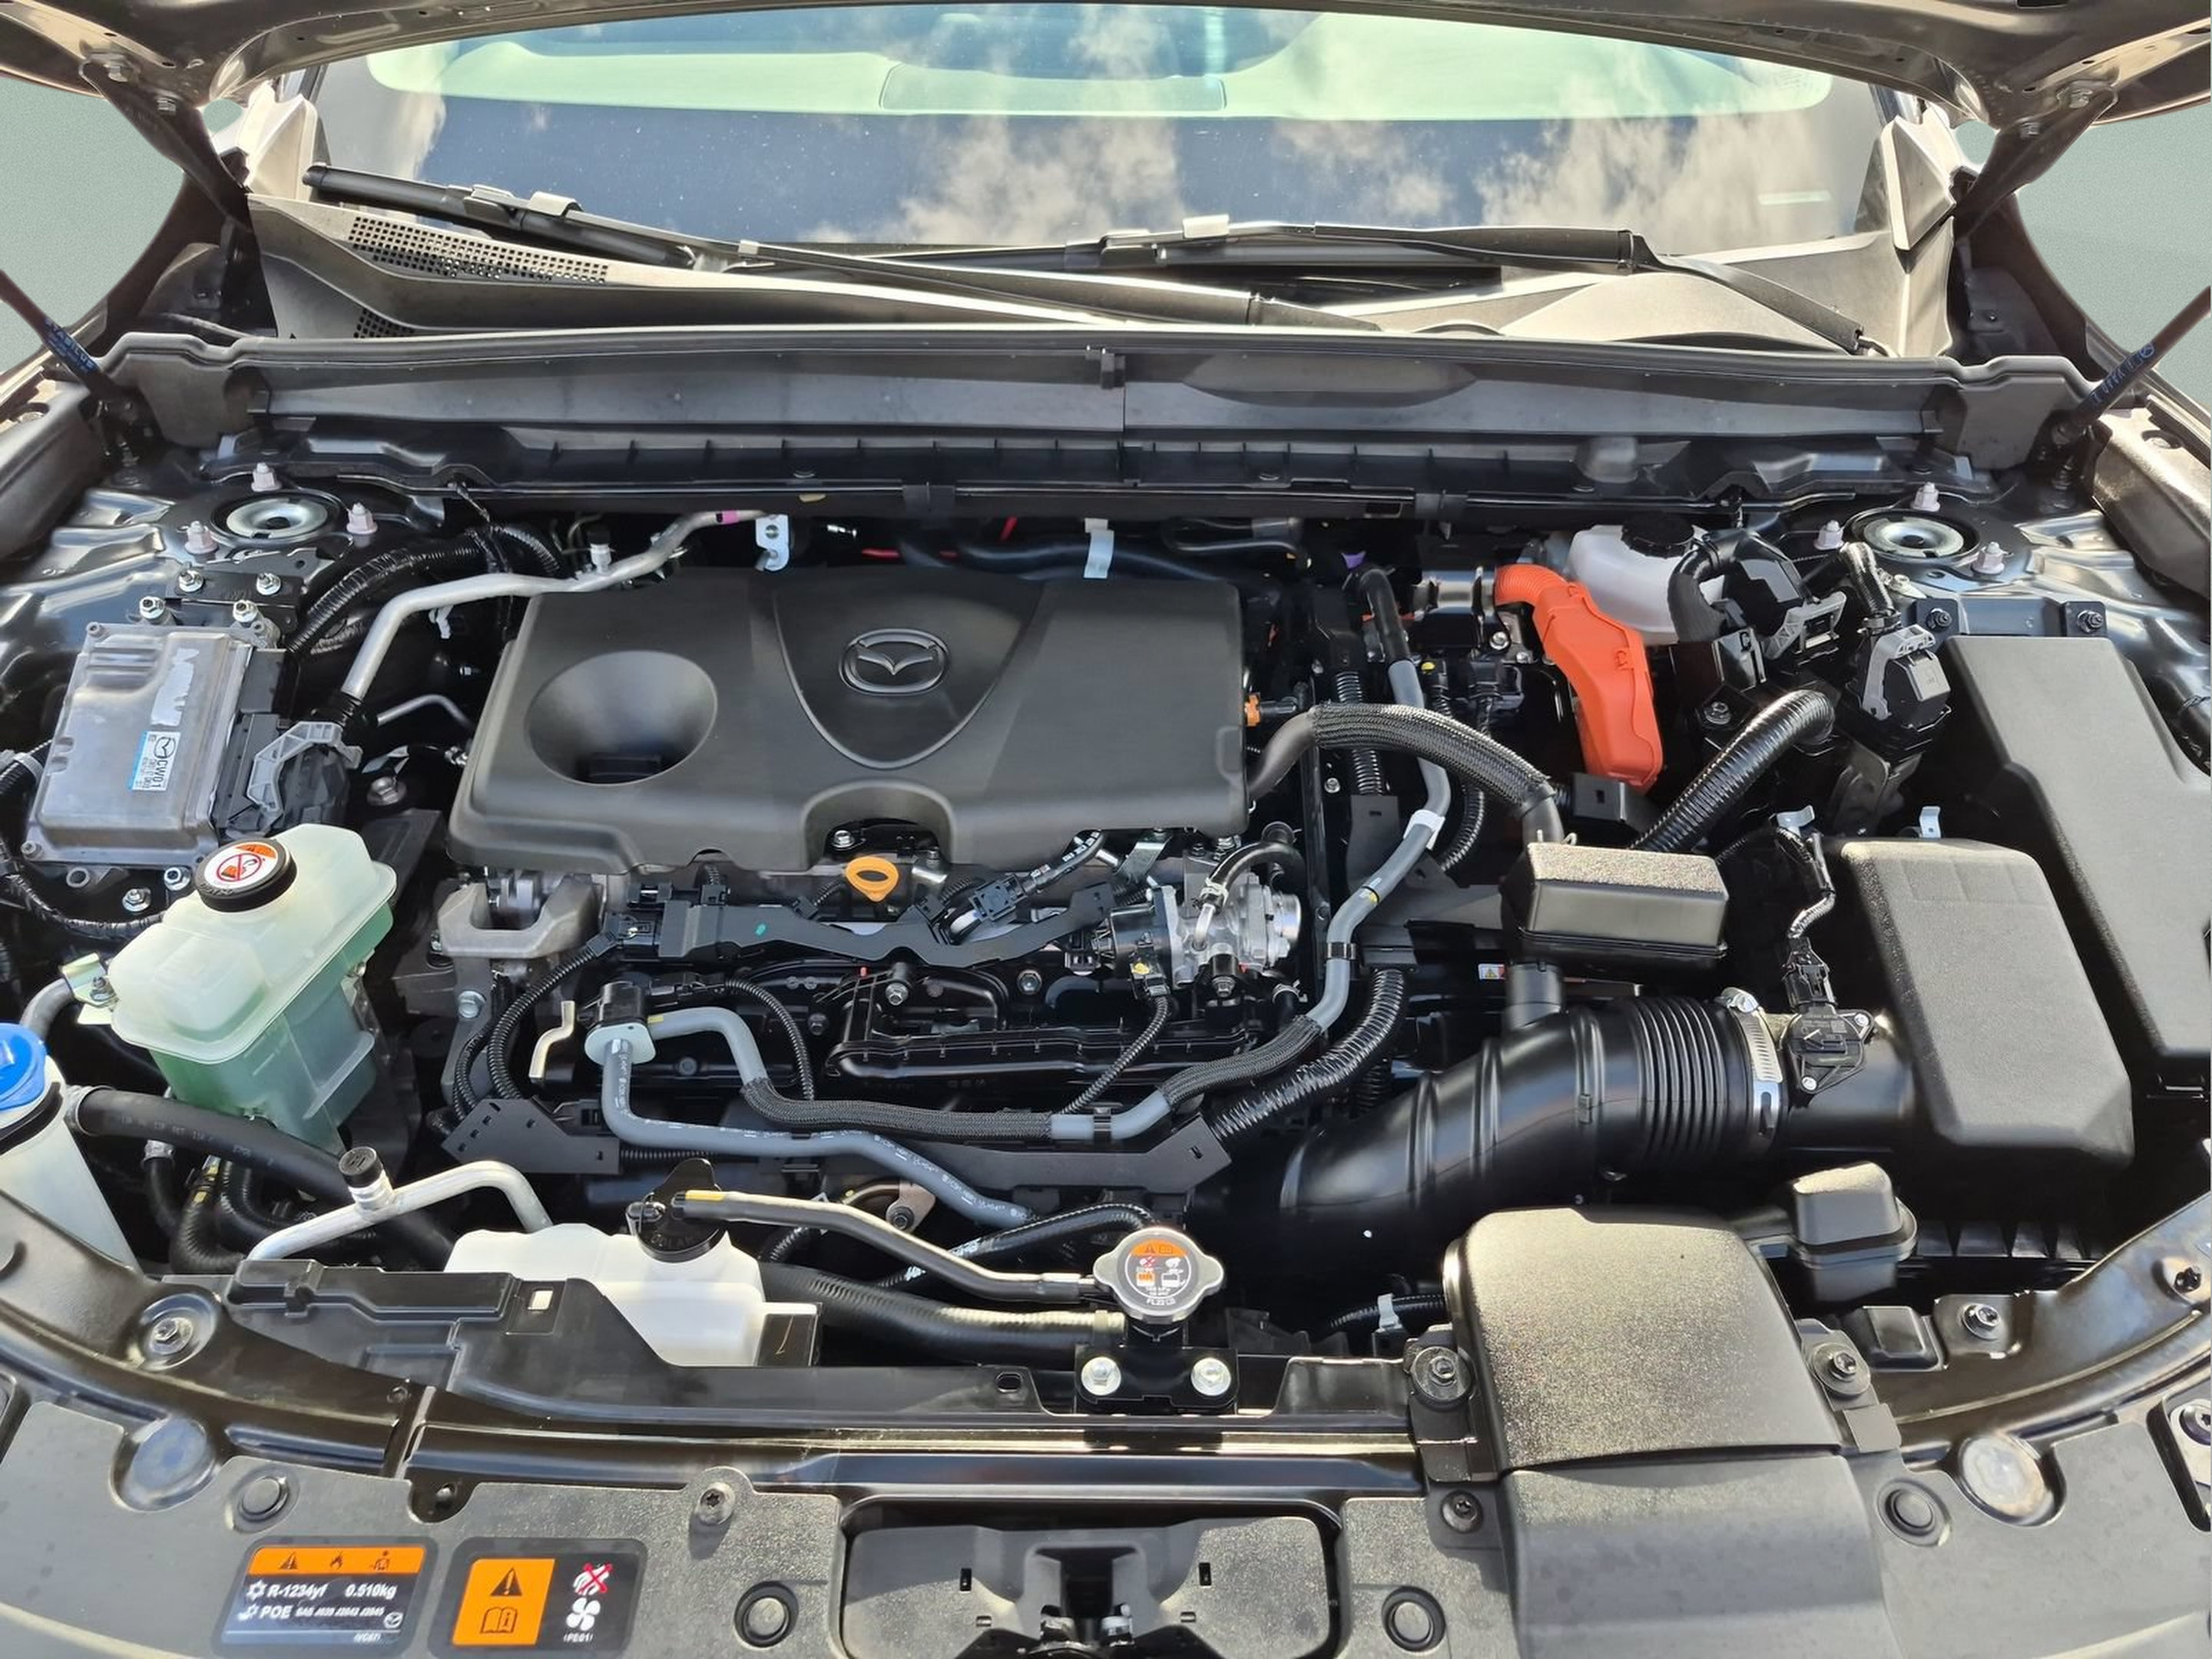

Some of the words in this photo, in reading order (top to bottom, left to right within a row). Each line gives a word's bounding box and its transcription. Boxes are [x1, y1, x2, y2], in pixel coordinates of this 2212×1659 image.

[267, 1583, 329, 1601] R-1234yf
[345, 1583, 398, 1600] 0.510kg
[260, 1604, 293, 1619] POE
